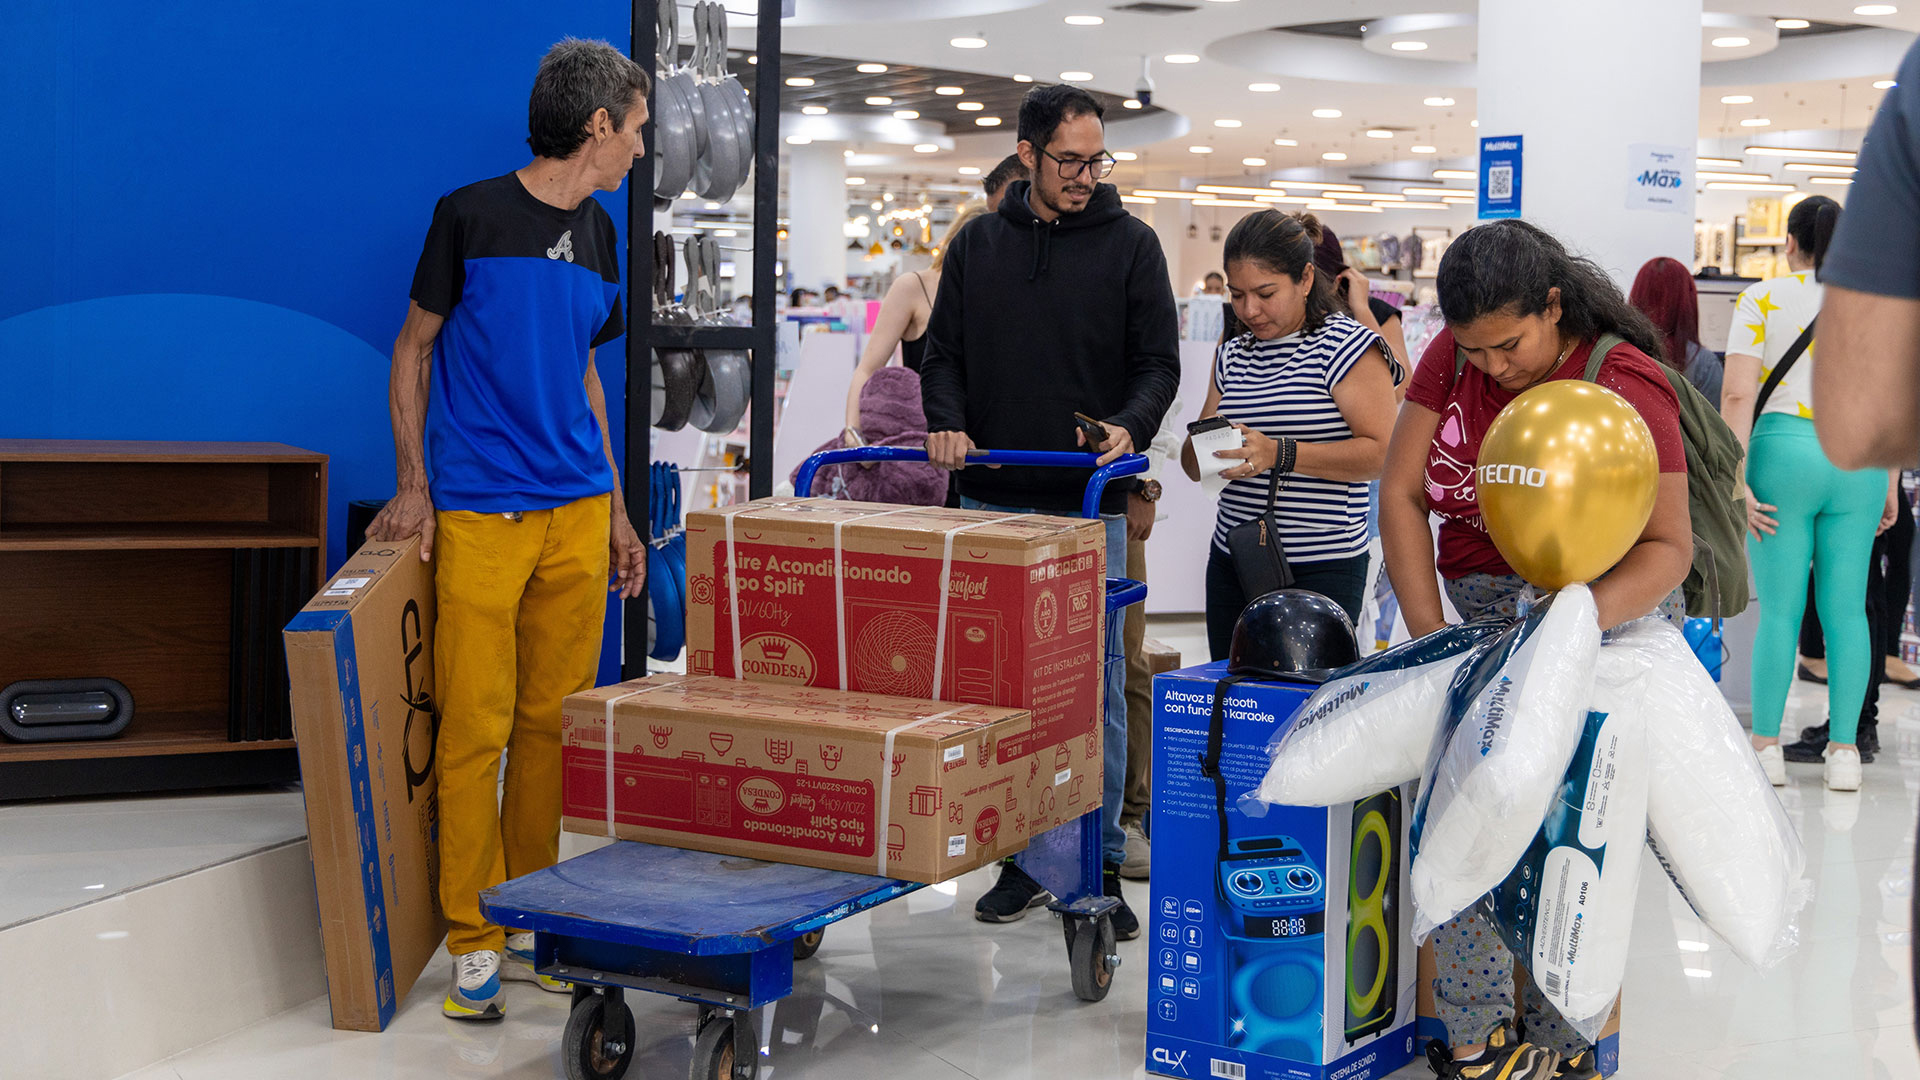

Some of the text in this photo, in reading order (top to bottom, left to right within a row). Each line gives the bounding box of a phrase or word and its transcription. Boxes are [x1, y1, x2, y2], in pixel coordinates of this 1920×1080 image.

[1641, 170, 1677, 188] Max
[1479, 464, 1546, 487] TECNO
[766, 555, 912, 584] Acondiionado
[723, 573, 805, 597] tpo Split
[722, 598, 792, 626] 20V/60Hz
[742, 659, 808, 679] CONDESA
[1033, 666, 1043, 679] KIT
[1043, 663, 1052, 676] DE
[1165, 690, 1257, 709] Altavoz Betooth
[1165, 704, 1274, 723] con funcn karaoke
[1480, 680, 1512, 750] MultiMax
[742, 787, 781, 799] CONDESA
[744, 820, 865, 847] Aire Acondicionado
[811, 815, 865, 832] tipo Split
[1578, 881, 1589, 906] A0106
[1163, 928, 1177, 938] LED
[1272, 918, 1306, 936] 88:88
[1567, 914, 1583, 963] MultiMax
[1152, 1047, 1188, 1075] CLX
[1330, 1065, 1350, 1080] SISTEMA
[1351, 1060, 1358, 1072] DE
